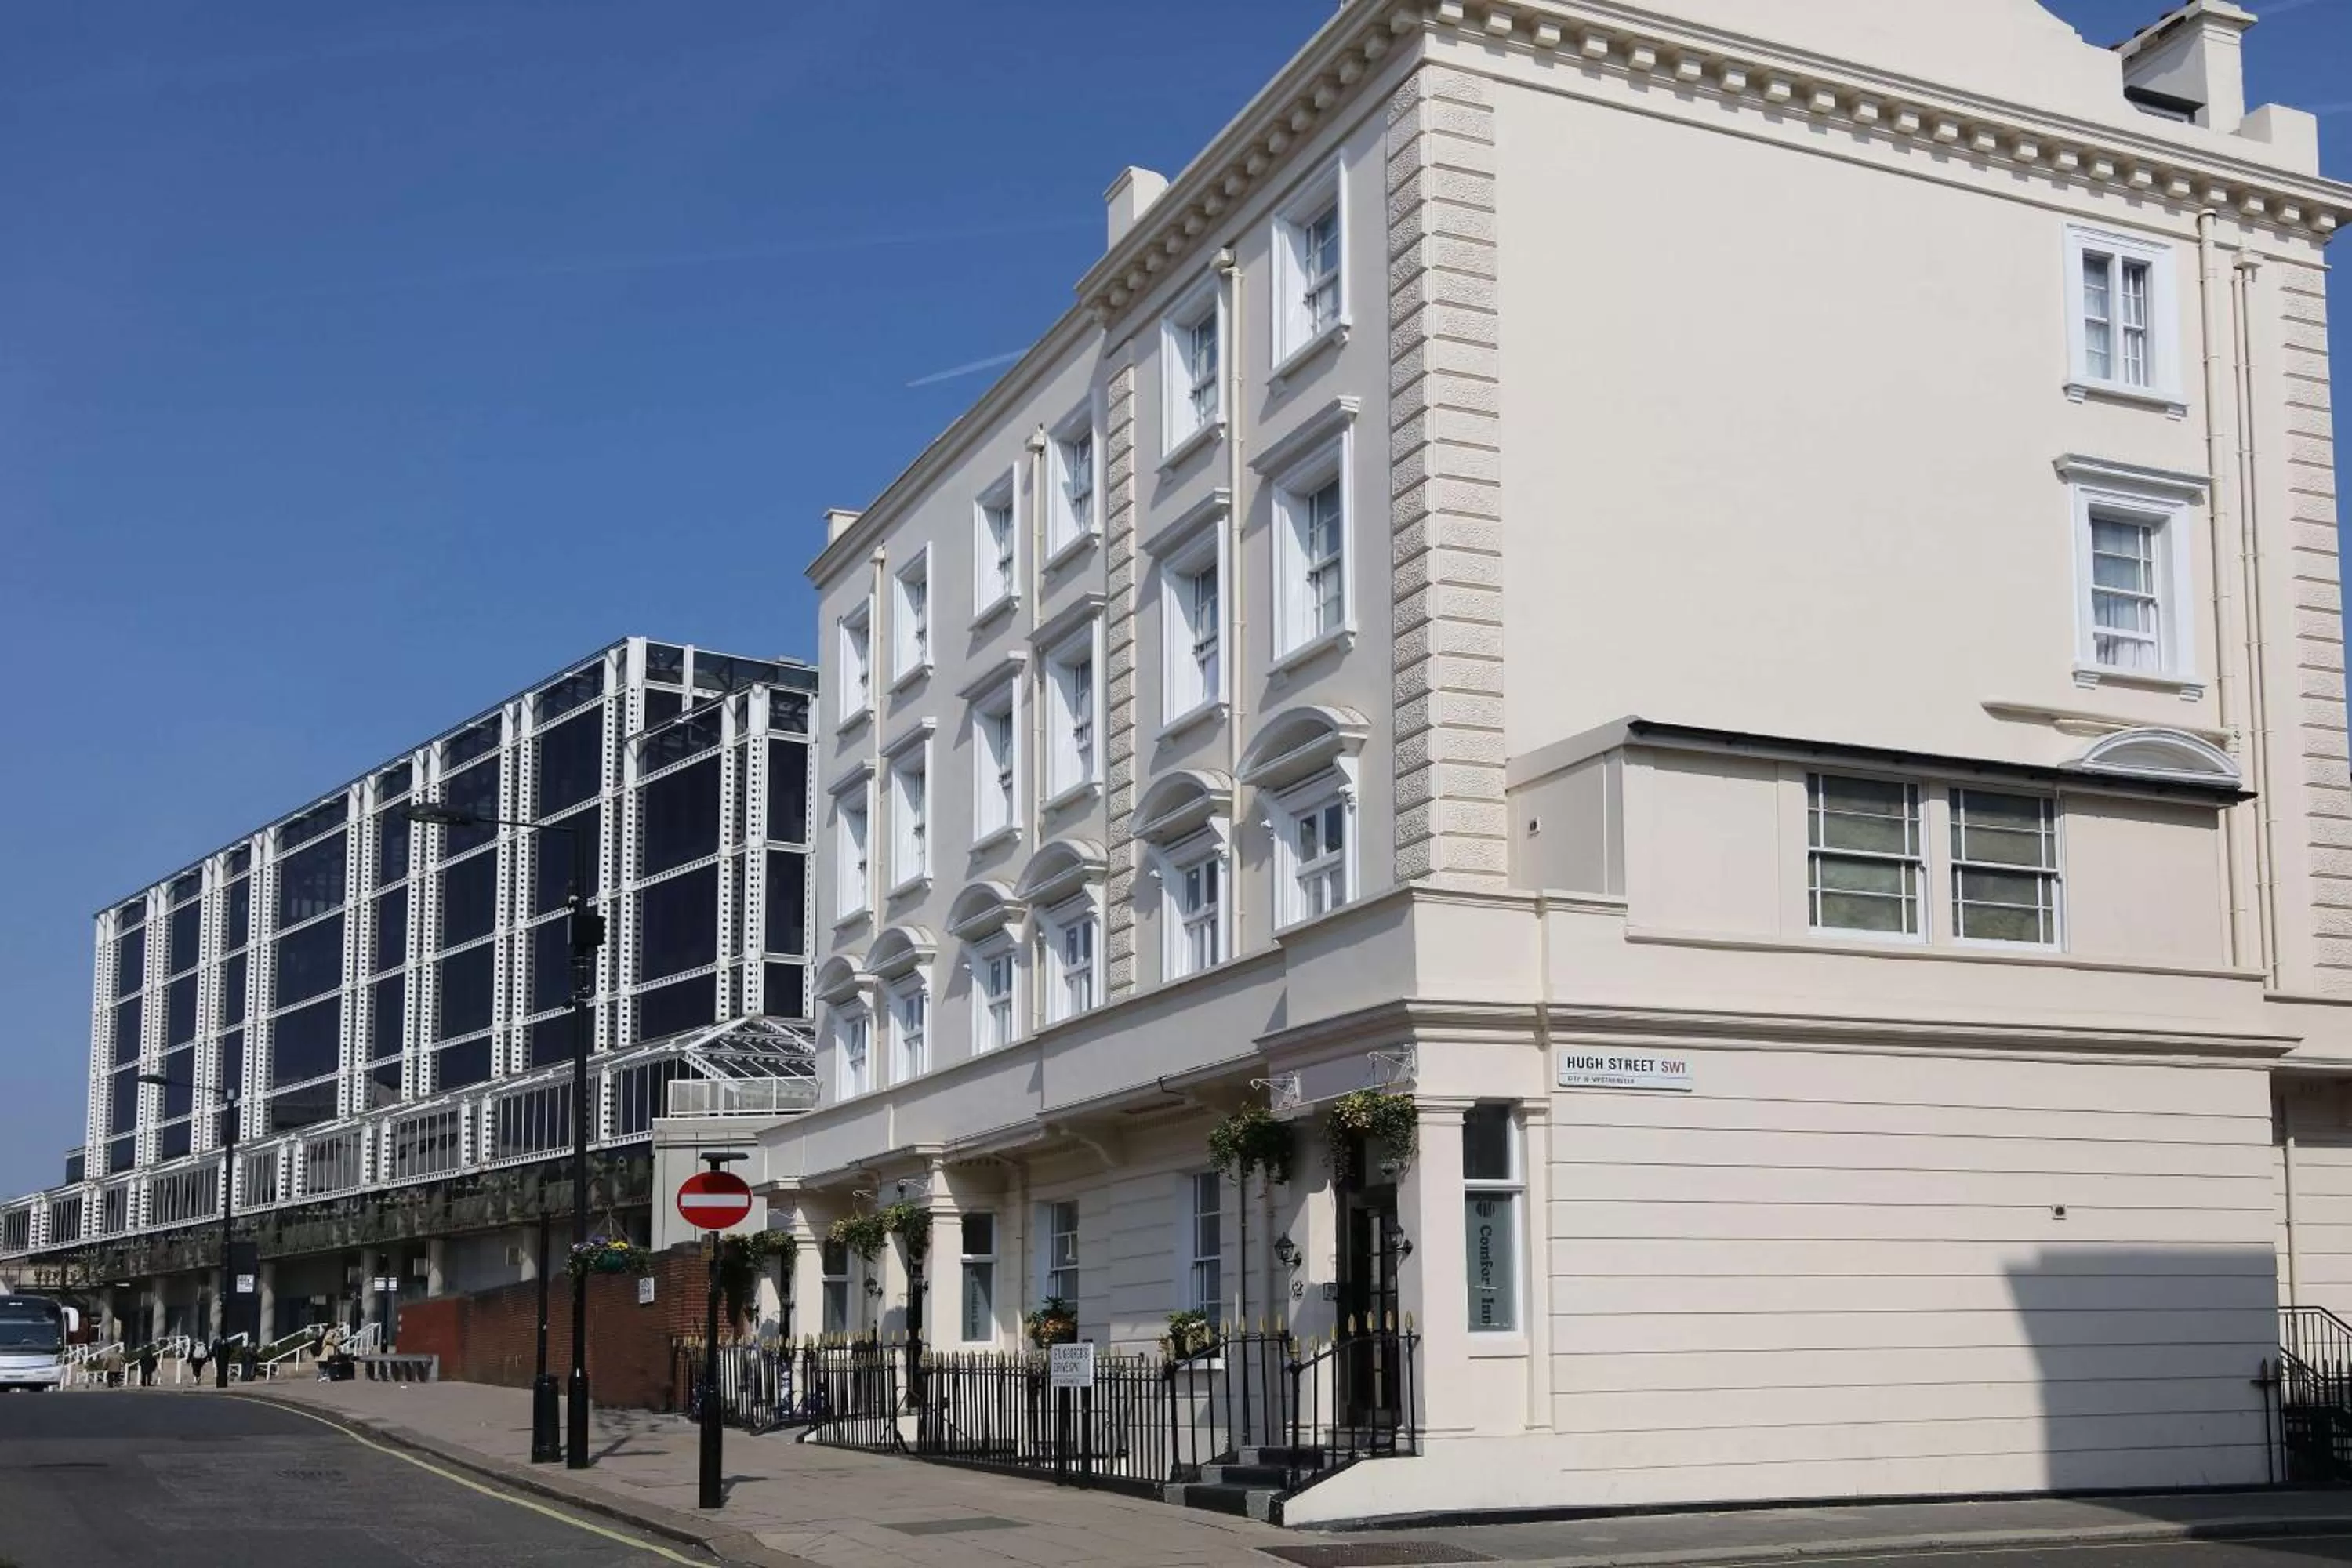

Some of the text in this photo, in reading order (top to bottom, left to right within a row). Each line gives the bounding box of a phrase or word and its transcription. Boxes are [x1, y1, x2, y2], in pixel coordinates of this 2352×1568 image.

[1567, 1056, 1686, 1073] HUGH STREET SW1
[1479, 1225, 1494, 1324] Comfort Inn
